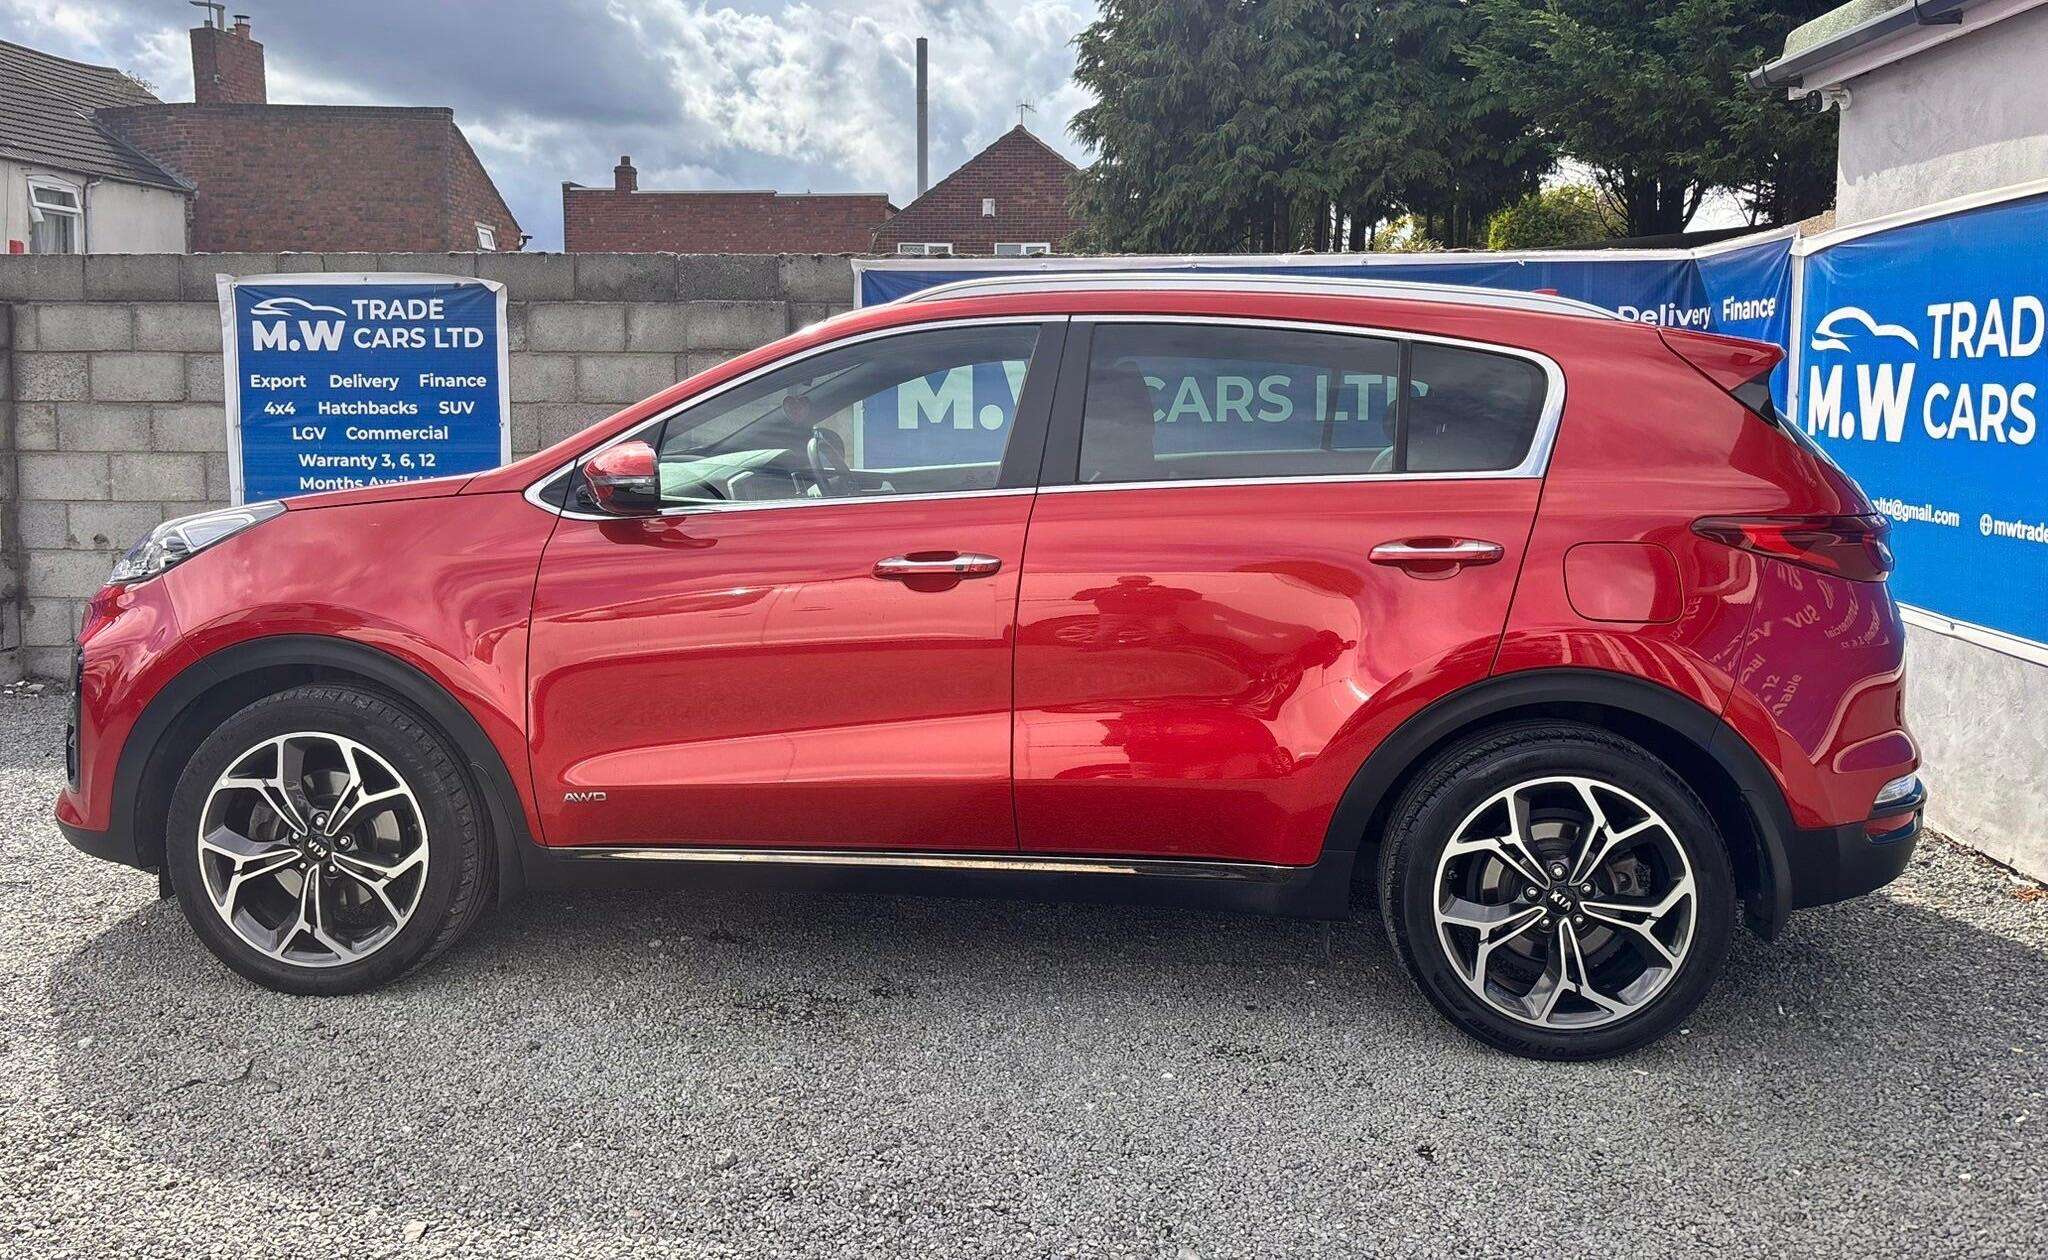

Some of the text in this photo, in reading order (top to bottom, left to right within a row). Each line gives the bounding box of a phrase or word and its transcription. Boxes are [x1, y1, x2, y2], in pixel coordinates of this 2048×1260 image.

[352, 299, 444, 320] TRADE
[1618, 296, 1775, 330] Delivery Finance
[251, 320, 346, 351] M.W
[353, 327, 484, 349] CARS LTD
[250, 373, 487, 391] Export Delivery Finance
[264, 401, 474, 415] 4x4 Hatchbacks SUV
[1807, 362, 1916, 442] M.W
[1923, 382, 2037, 446] CARS
[292, 426, 449, 440] LGV Commercial
[298, 453, 436, 470] Warranty 3, 6, 12
[300, 475, 363, 490] Months
[562, 792, 607, 803] AWD
[308, 838, 327, 858] KIA
[1550, 890, 1572, 911] KIA
